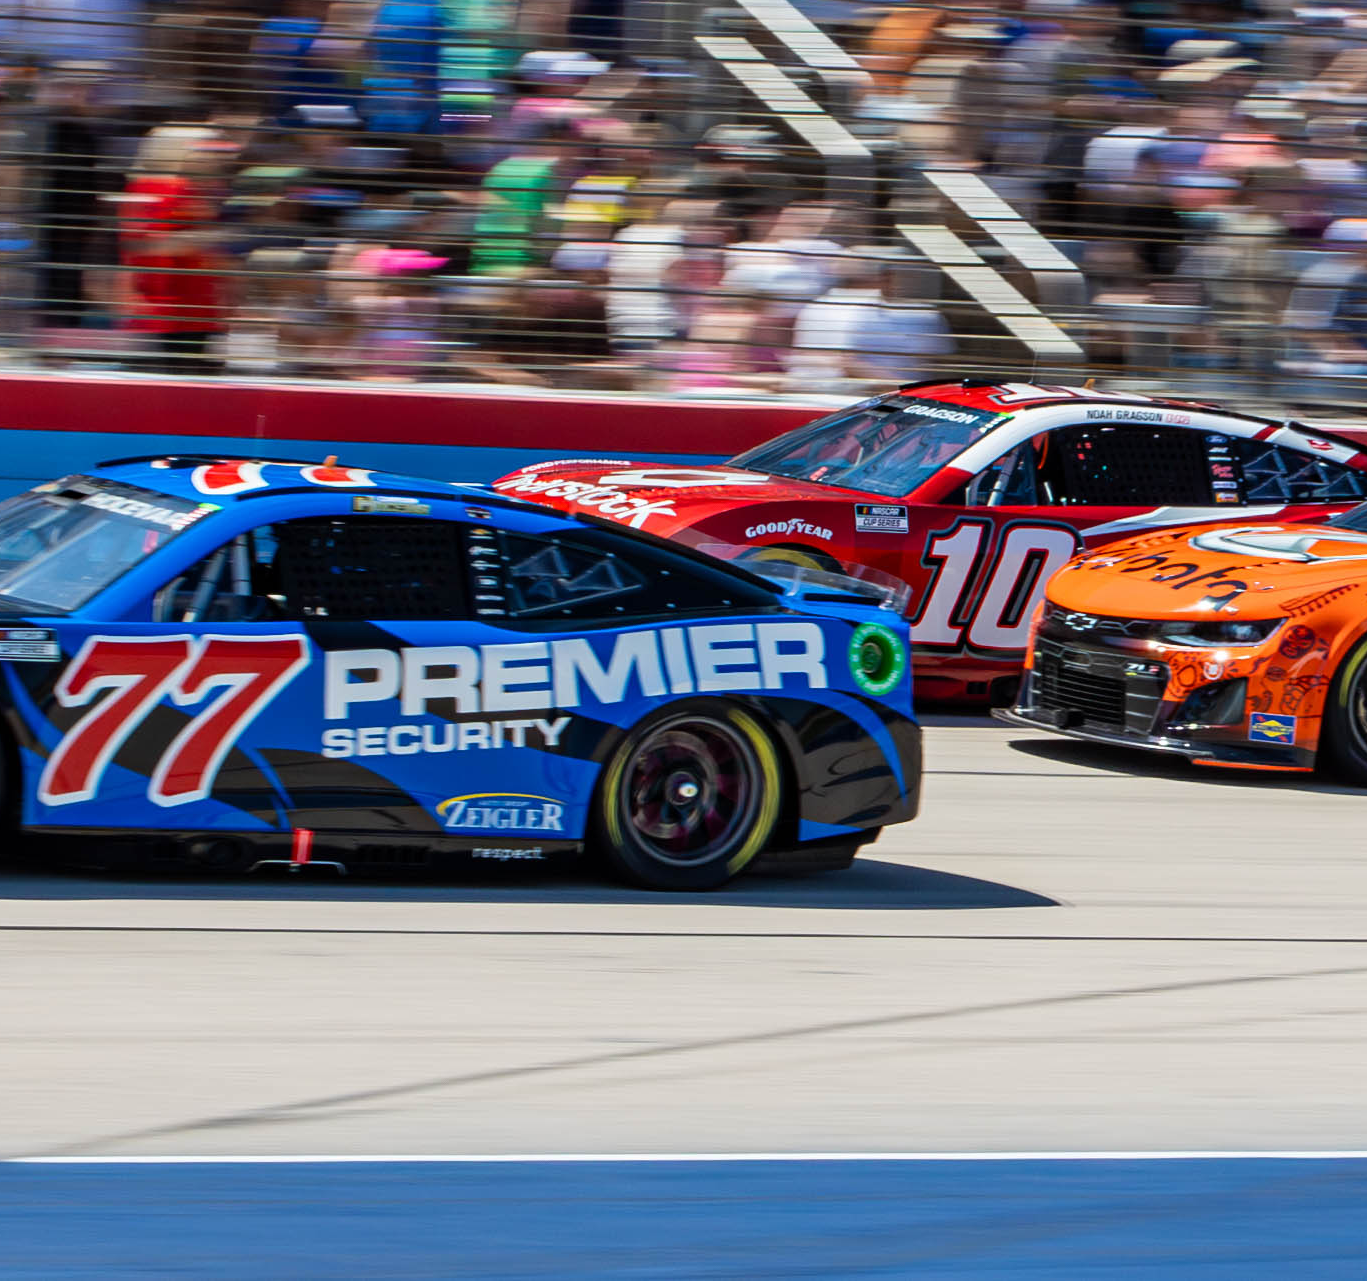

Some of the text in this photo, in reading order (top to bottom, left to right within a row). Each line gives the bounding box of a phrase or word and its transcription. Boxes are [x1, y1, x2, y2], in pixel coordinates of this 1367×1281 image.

[902, 404, 980, 424] GRAGSON
[1086, 410, 1112, 420] NOAH
[1115, 410, 1163, 422] GRAGSON
[745, 518, 833, 541] GOODYEAR
[862, 518, 901, 527] CUP SERIES
[911, 519, 1081, 656] 10
[324, 621, 829, 719] PREMIER
[37, 633, 311, 806] 77
[321, 716, 573, 759] SECURITY
[445, 800, 564, 831] ZEIGLER
